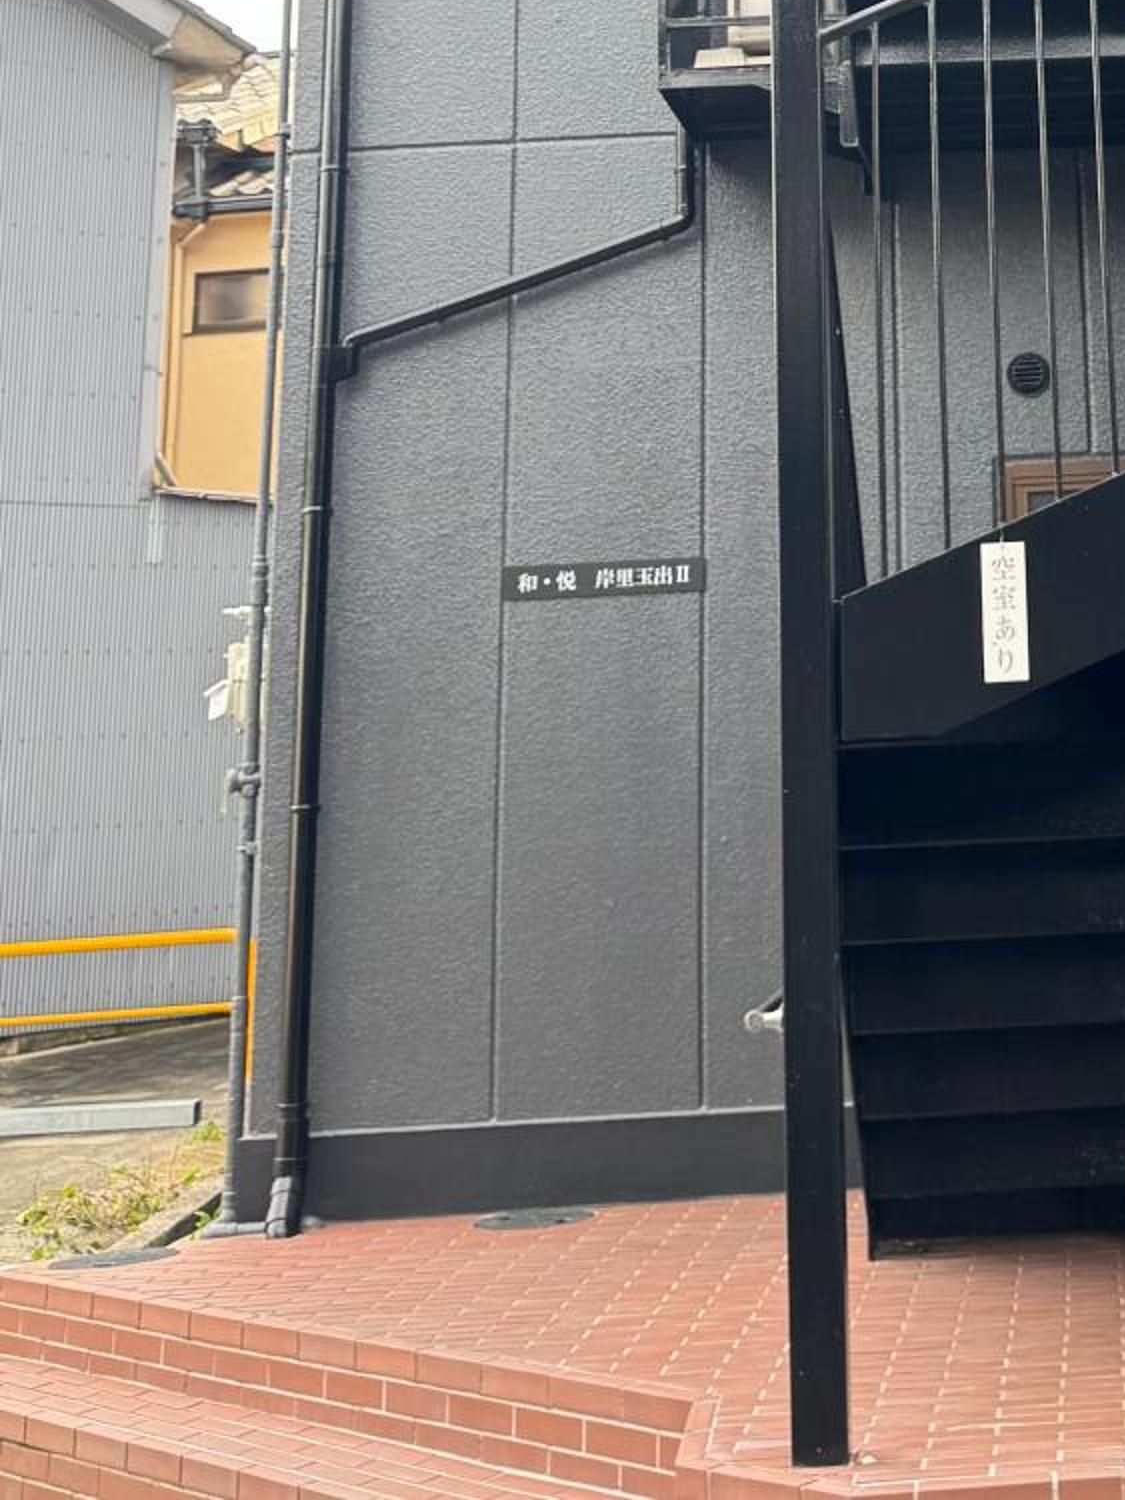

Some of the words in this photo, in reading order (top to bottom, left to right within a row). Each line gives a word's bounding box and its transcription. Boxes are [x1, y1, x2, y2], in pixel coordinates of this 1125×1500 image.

[517, 569, 577, 593] 和・悦
[991, 555, 1017, 675] 空室あり
